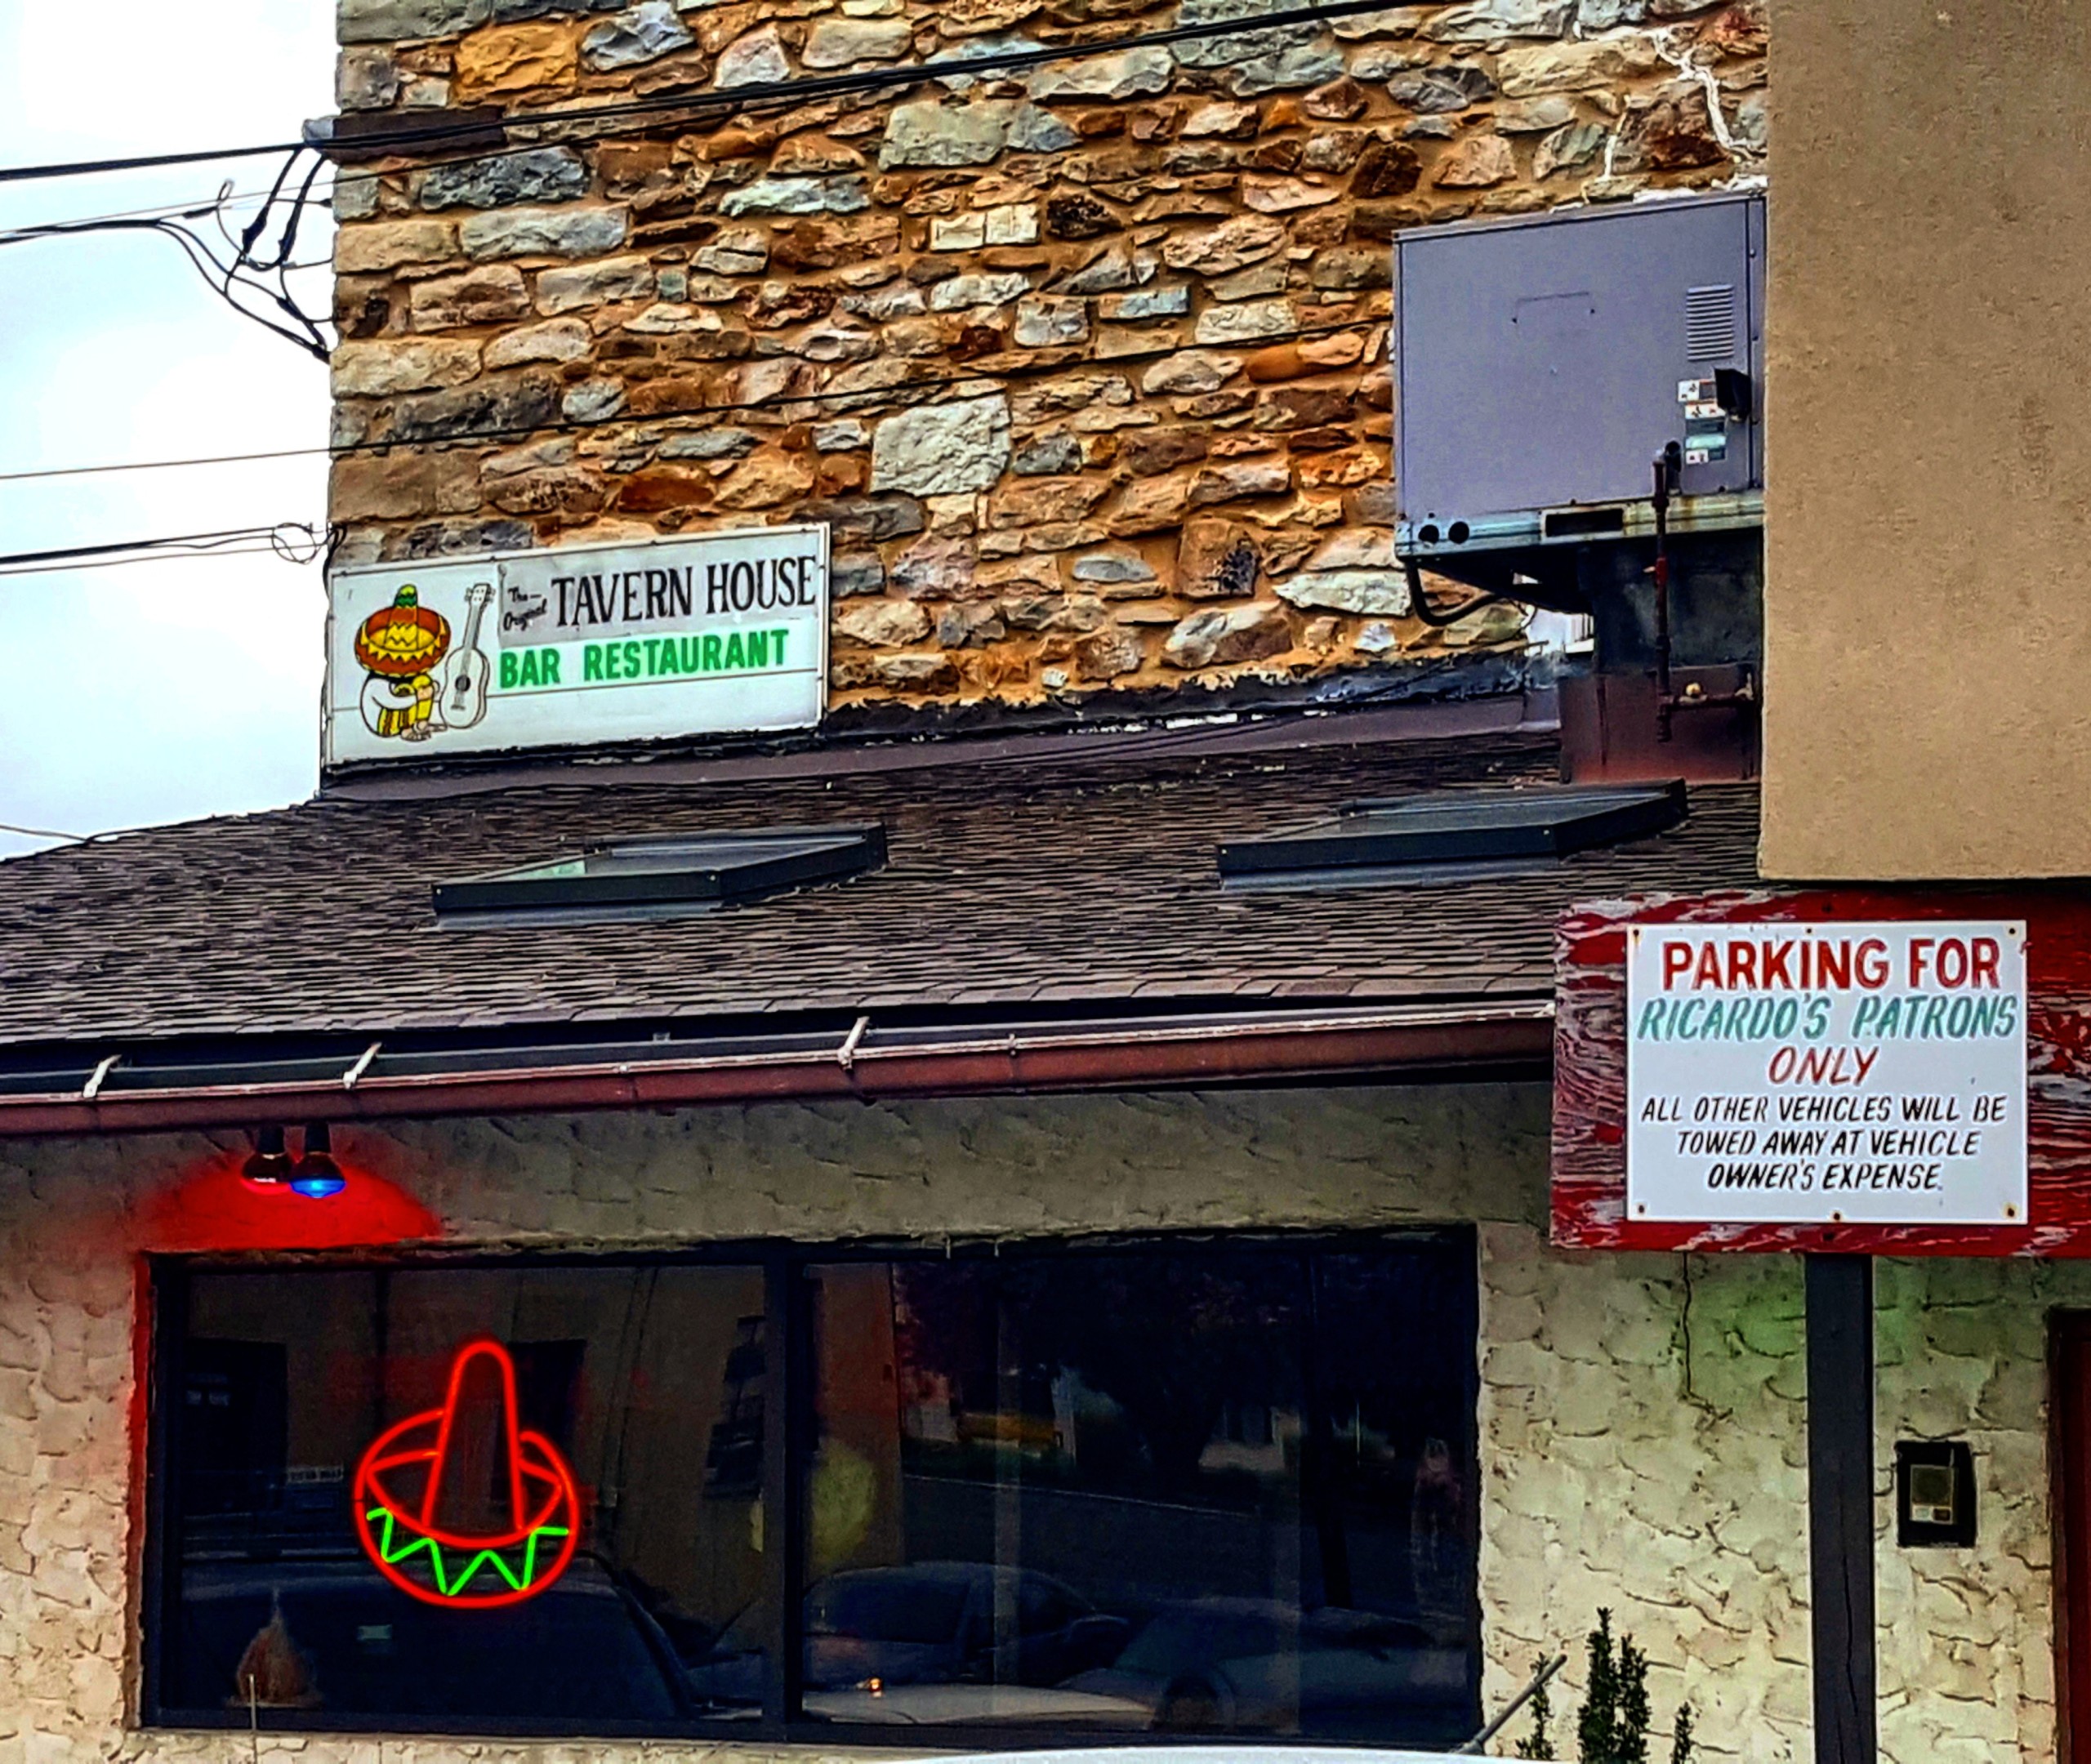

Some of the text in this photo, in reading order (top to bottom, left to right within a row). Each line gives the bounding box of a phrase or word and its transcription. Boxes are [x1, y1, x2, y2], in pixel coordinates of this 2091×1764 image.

[551, 555, 817, 628] TAVERN HOUSE
[500, 629, 789, 689] BAR RESTAURANT
[1662, 938, 2000, 991] PARKING FOR
[1637, 992, 2018, 1041] RICARDO'S PATRONS
[1768, 1045, 1879, 1086] ONLY
[1641, 1096, 2008, 1122] ALL OTHER VEHICLES WILL BE
[1677, 1130, 1982, 1156] TOWED AWAY AT VEHICLE
[1707, 1159, 1814, 1189] OWNER'S
